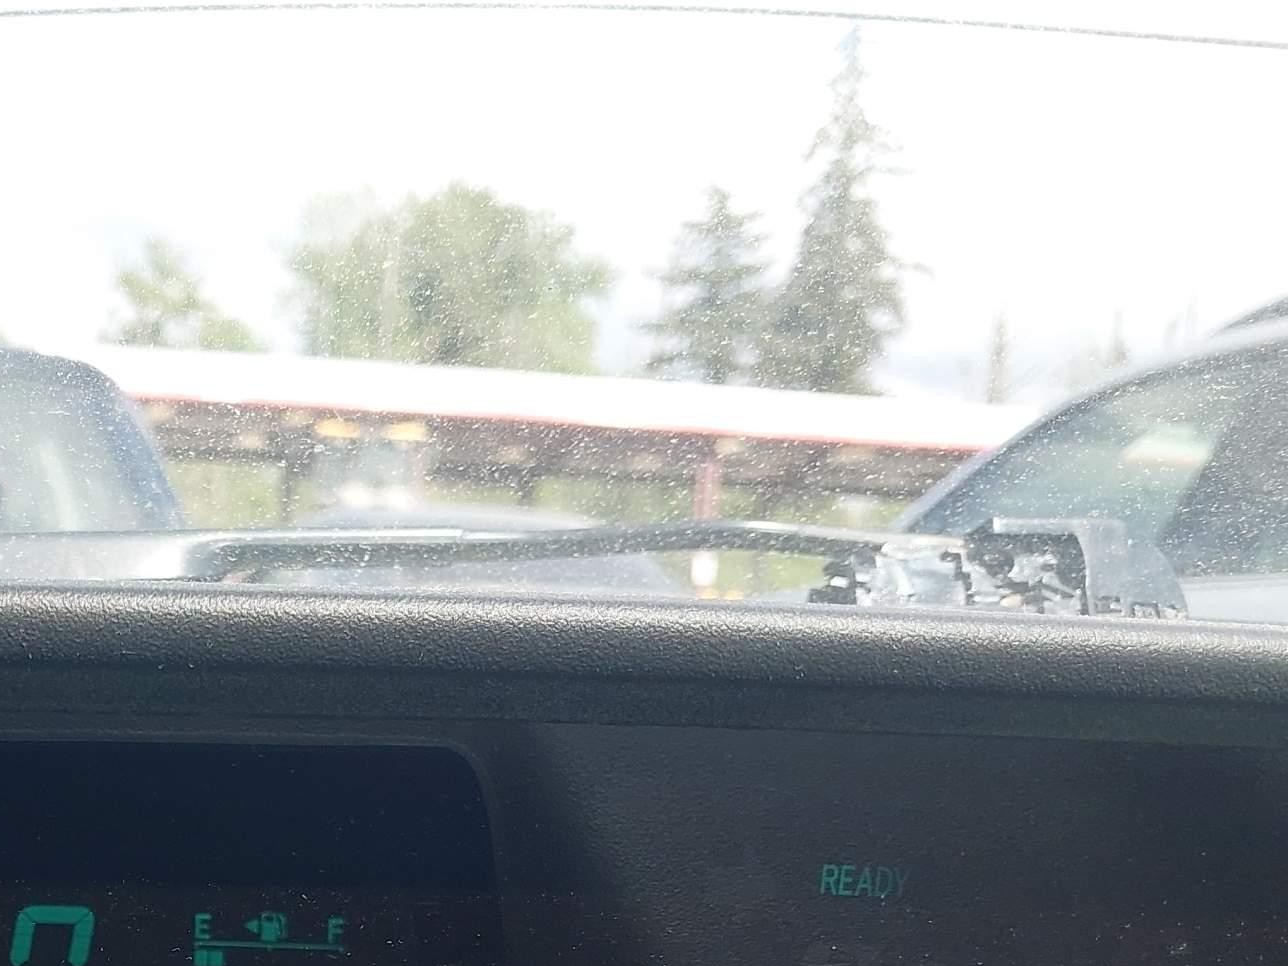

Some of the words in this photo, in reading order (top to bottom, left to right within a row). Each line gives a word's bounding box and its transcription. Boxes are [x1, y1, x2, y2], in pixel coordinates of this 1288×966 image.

[819, 863, 909, 897] READY
[194, 913, 212, 940] E
[327, 914, 344, 944] F
